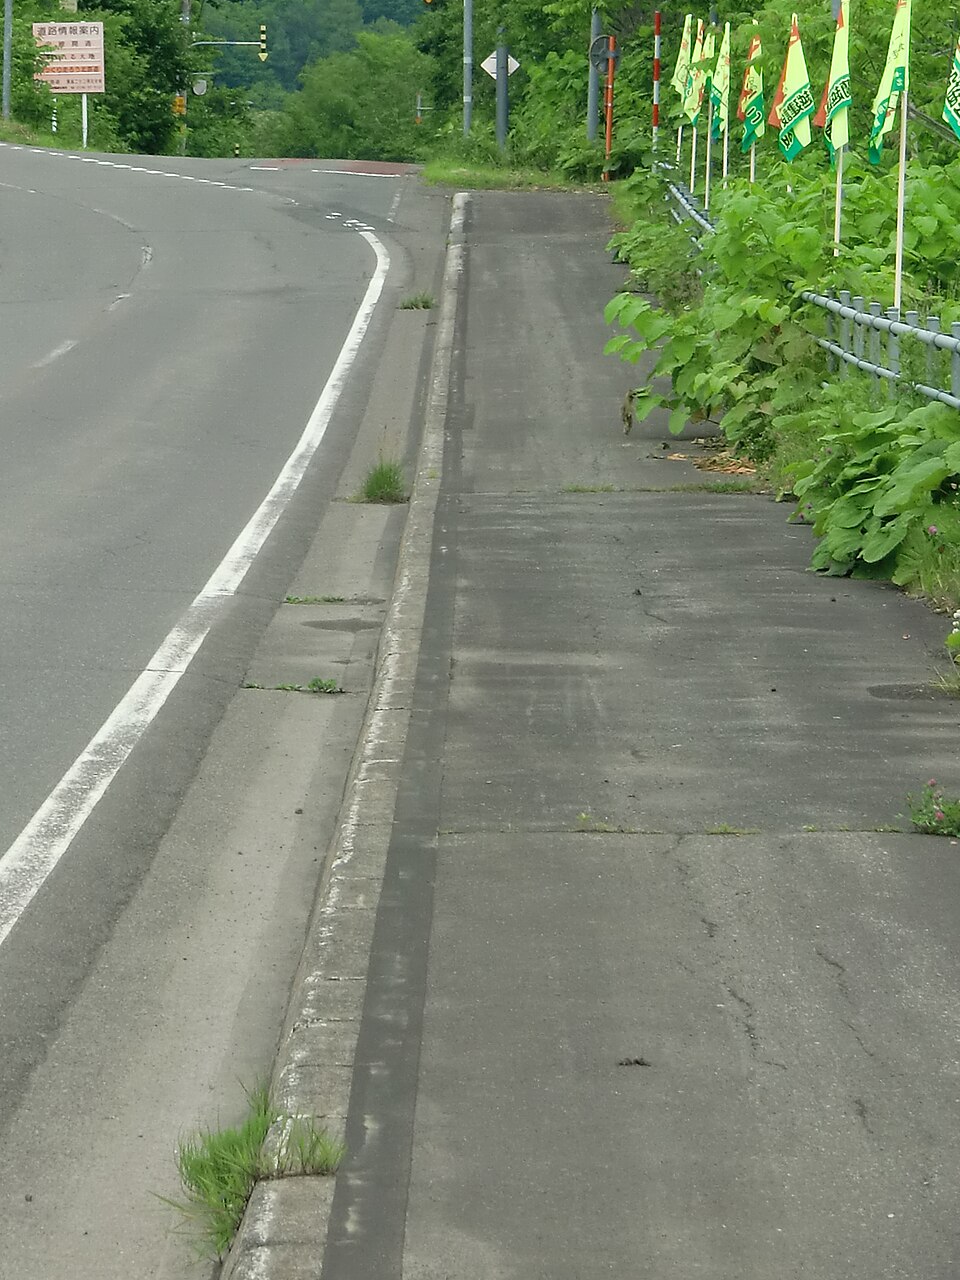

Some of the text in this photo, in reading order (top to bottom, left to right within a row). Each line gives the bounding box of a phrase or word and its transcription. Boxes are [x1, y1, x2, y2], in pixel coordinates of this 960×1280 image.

[37, 26, 99, 36] 道路情報案内
